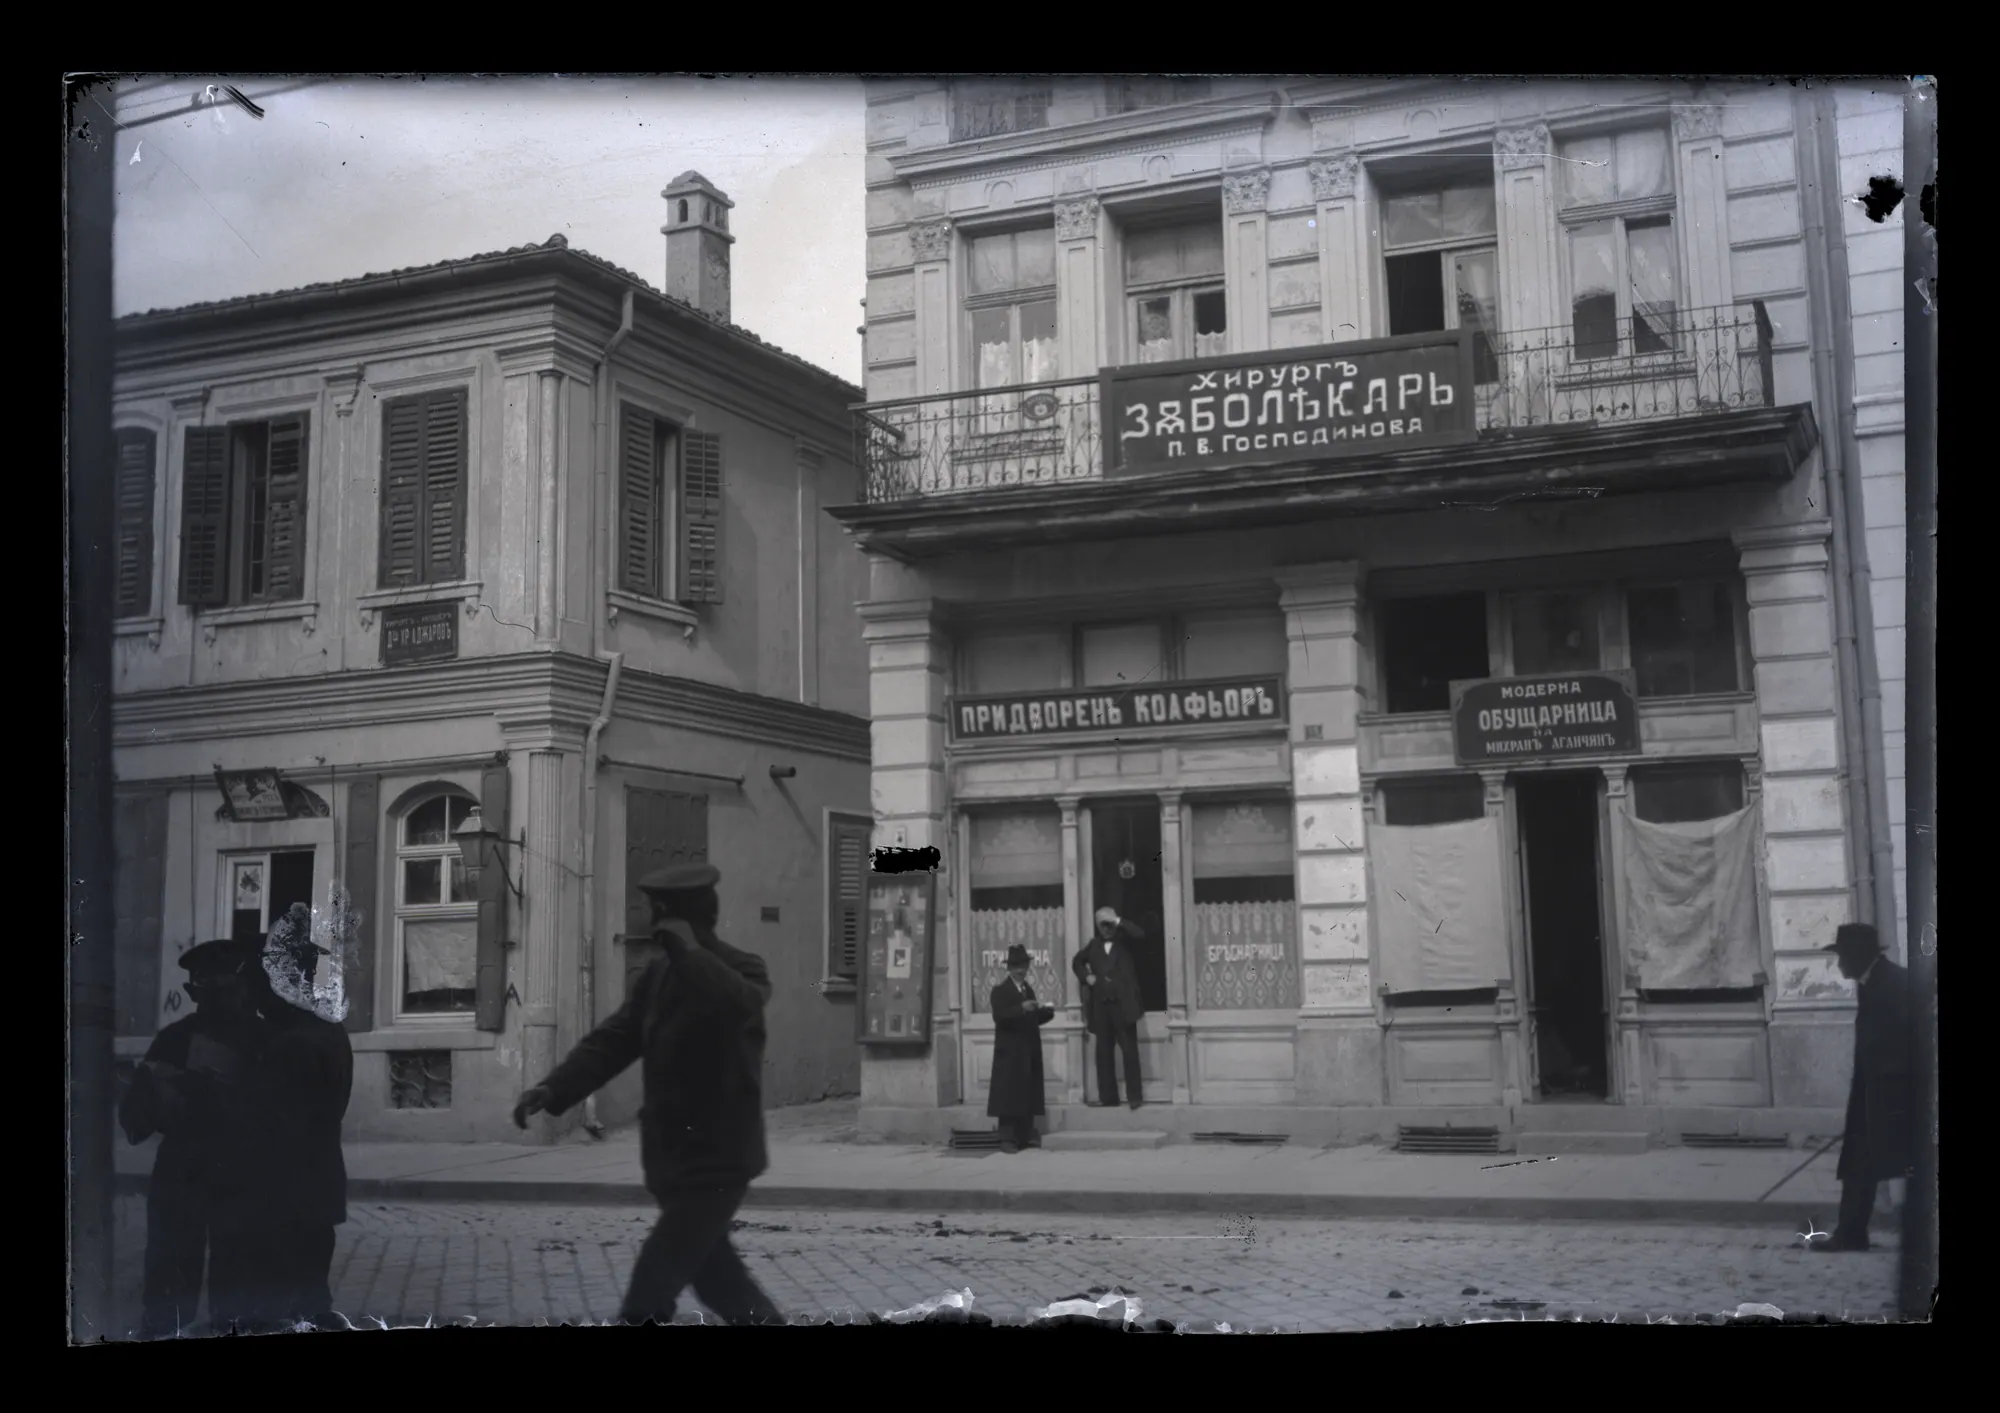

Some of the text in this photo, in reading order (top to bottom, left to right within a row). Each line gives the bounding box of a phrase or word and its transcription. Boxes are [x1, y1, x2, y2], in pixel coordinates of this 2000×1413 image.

[1501, 681, 1582, 699] МОДЕРНА
[961, 686, 1275, 733] ПРИДВОРЕНЪ КОАФЬОРЪ
[1478, 700, 1618, 731] ОБУЩАРНИЦА
[1486, 738, 1543, 754] МИХРАНЪ
